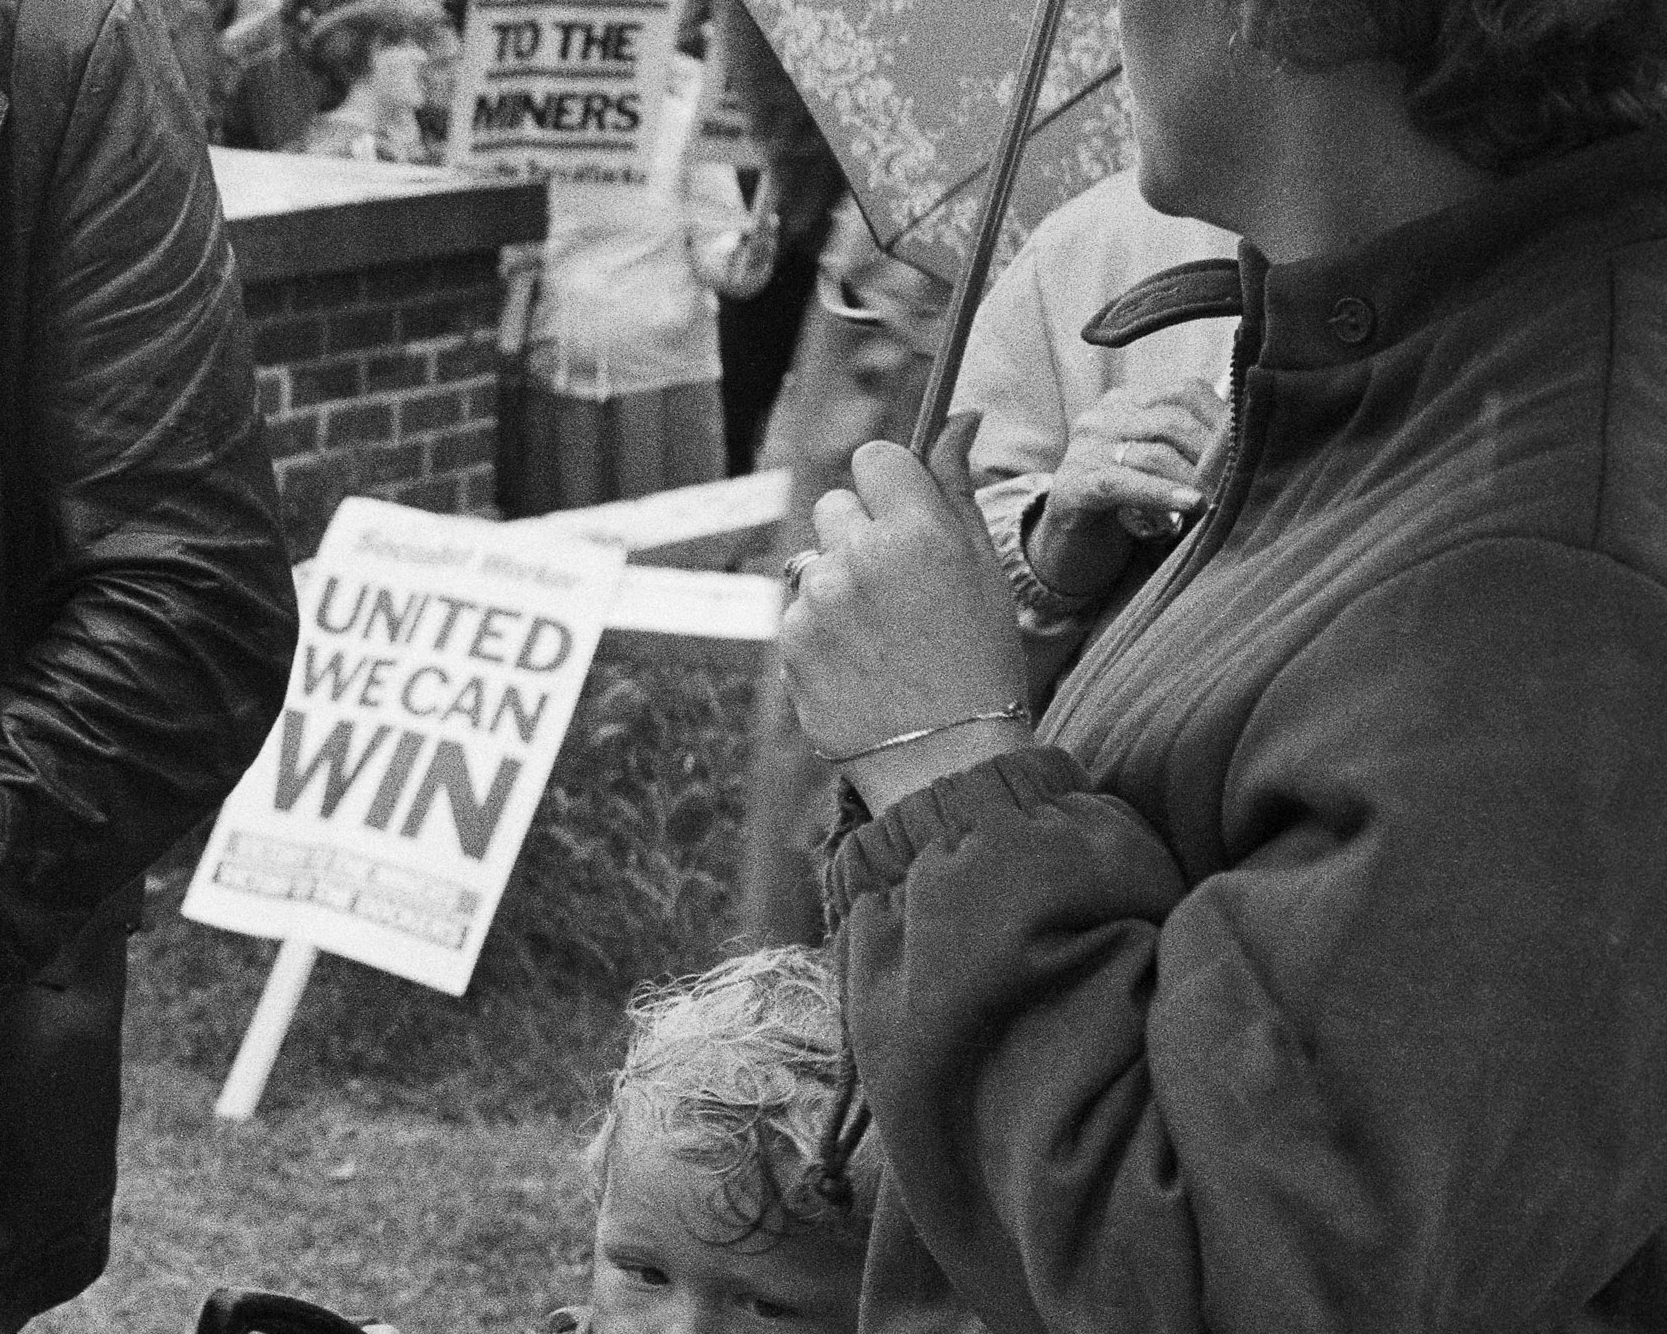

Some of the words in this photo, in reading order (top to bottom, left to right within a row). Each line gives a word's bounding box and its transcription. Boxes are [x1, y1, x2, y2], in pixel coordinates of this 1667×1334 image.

[493, 21, 541, 62] TO
[556, 21, 642, 62] THE
[472, 93, 641, 132] MINERS
[315, 576, 573, 673] UNITED
[302, 646, 395, 709] WE
[401, 665, 550, 743] CAN
[273, 709, 522, 862] WIN
